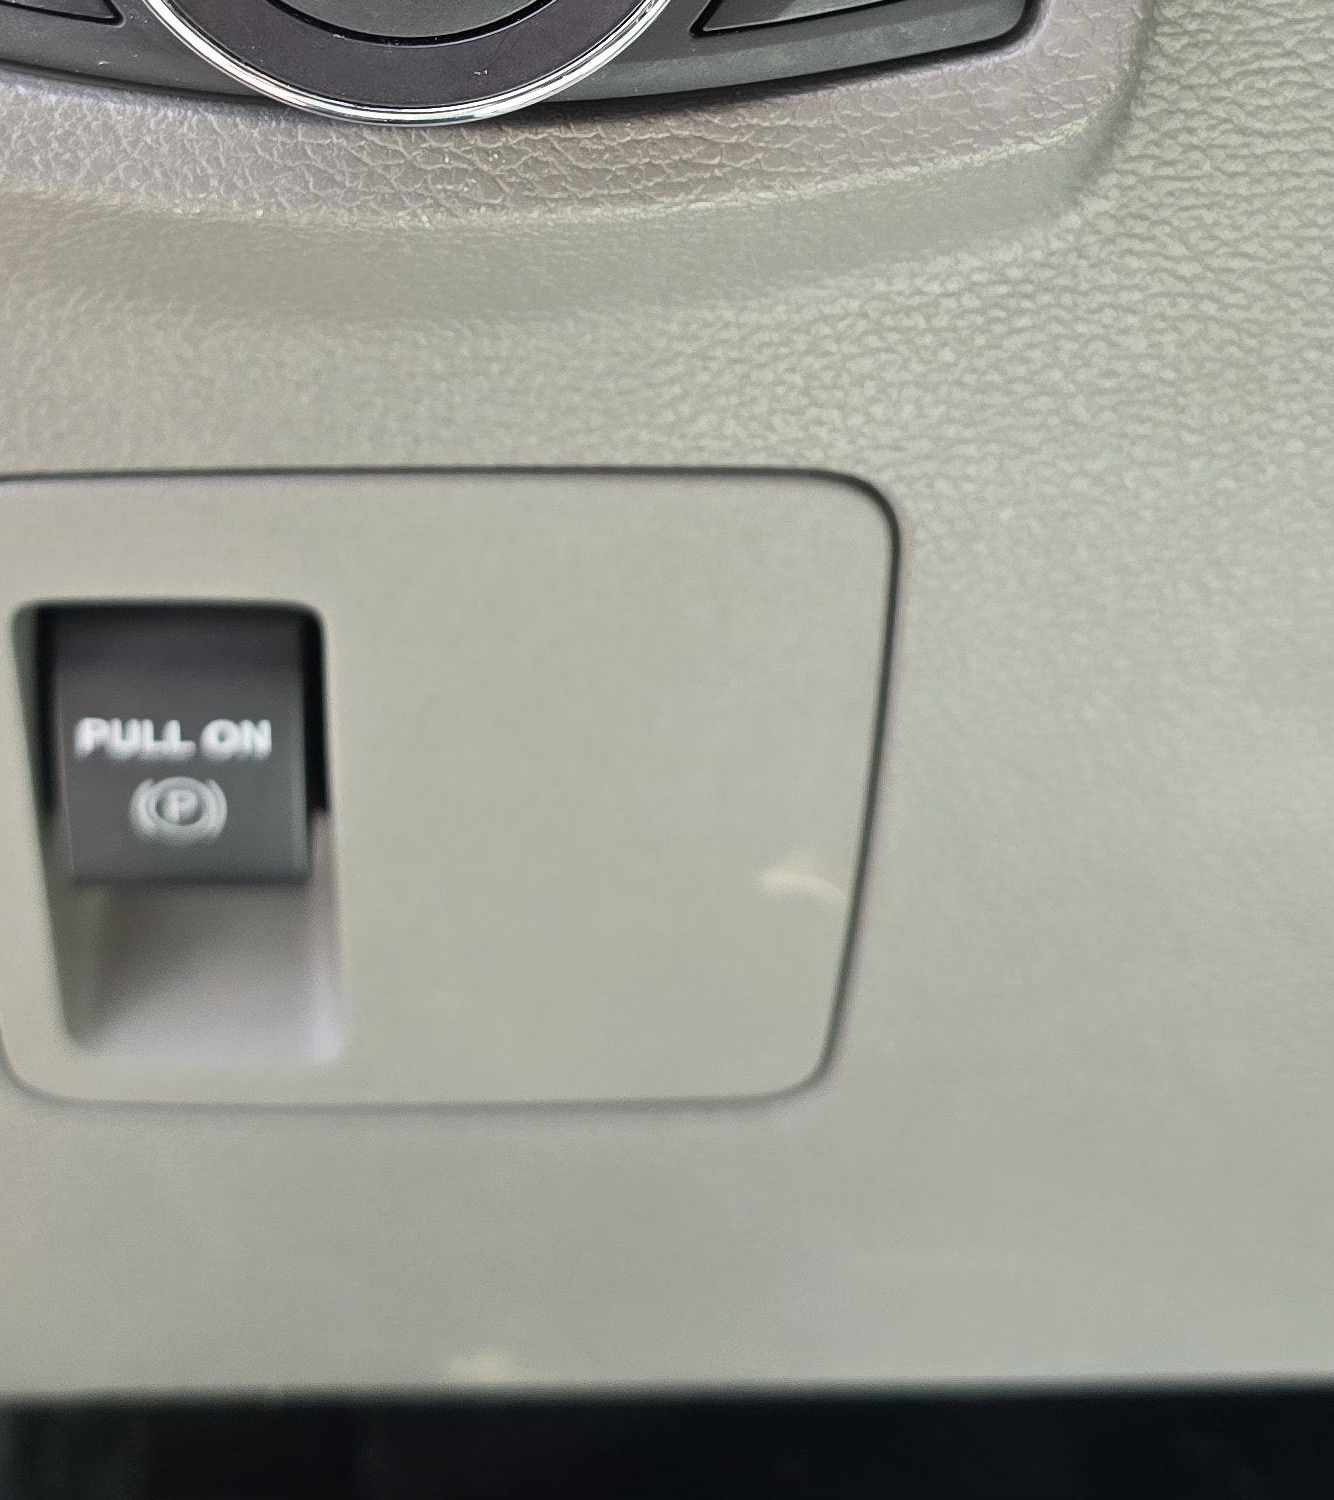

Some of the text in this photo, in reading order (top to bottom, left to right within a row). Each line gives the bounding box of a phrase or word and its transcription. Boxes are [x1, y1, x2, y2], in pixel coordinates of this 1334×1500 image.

[74, 717, 272, 762] PULL ON
[166, 790, 198, 823] P
